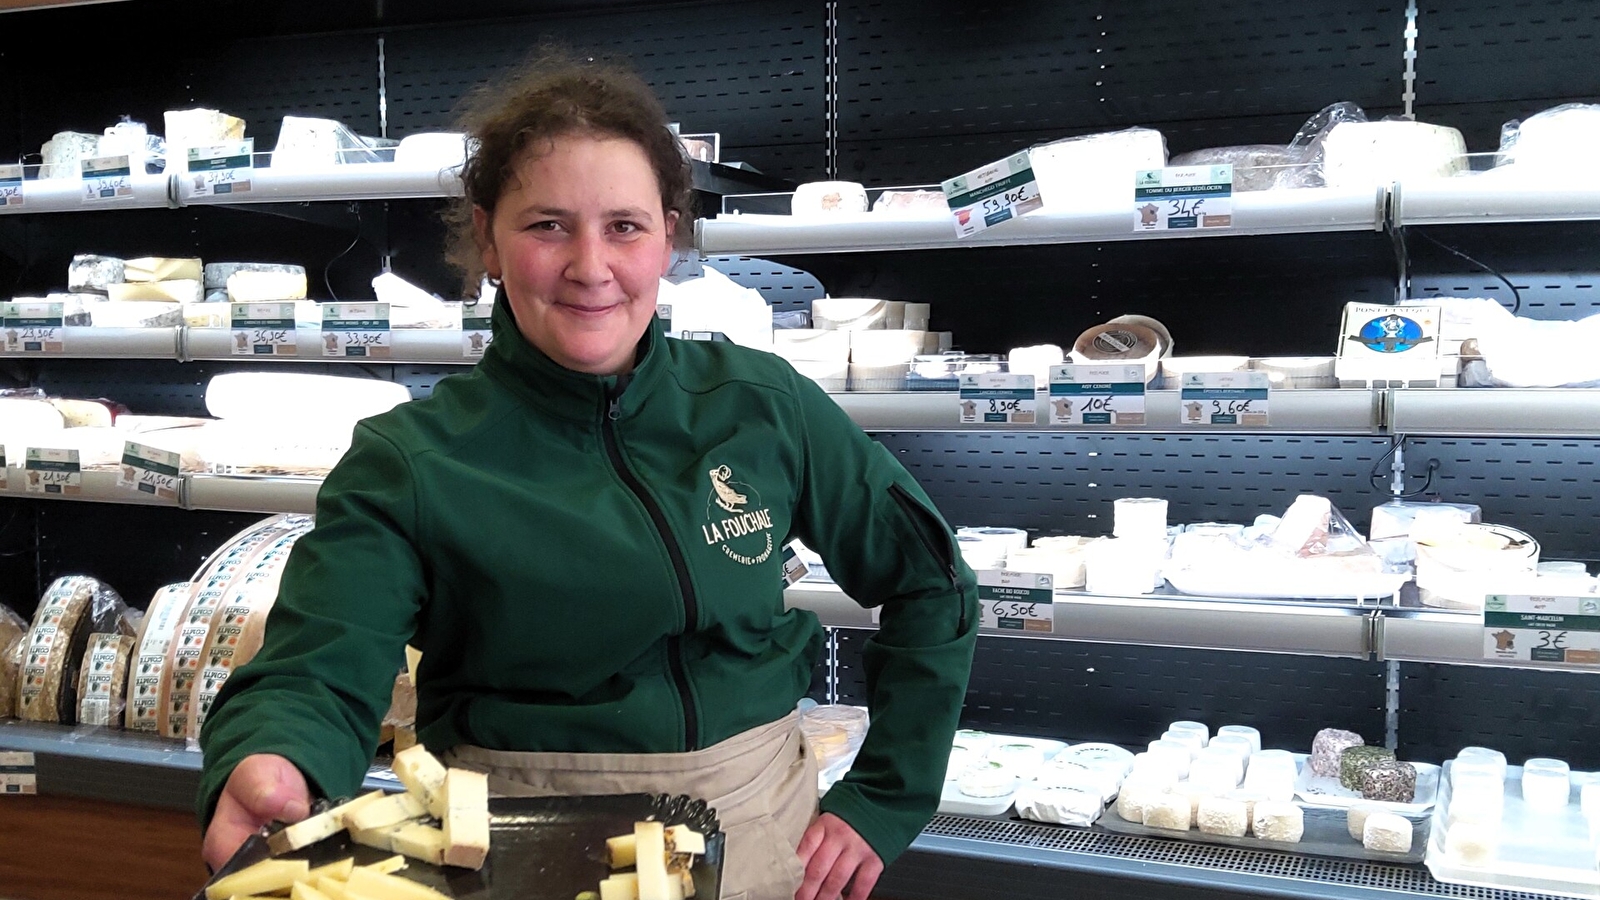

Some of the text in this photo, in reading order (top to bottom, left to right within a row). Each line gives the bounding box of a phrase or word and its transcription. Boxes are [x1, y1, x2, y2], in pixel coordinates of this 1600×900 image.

[969, 184, 995, 198] MANCHEGO
[1173, 186, 1191, 194] BERGER
[982, 187, 1029, 216] 59,90€
[1168, 199, 1205, 217] 34€
[20, 327, 54, 341] 23,90€
[253, 329, 287, 345] 36,90€
[345, 332, 382, 347] 33,90€
[989, 399, 1021, 414] 8,90€
[1080, 395, 1114, 412] 10€
[1212, 399, 1252, 416] 9,60€
[141, 469, 173, 488] 21,50€
[702, 508, 773, 546] LA FOUCHALE
[992, 599, 1039, 619] 6,50€
[1520, 614, 1565, 622] SAINT-MARCELLIN
[1537, 631, 1571, 650] 3€
